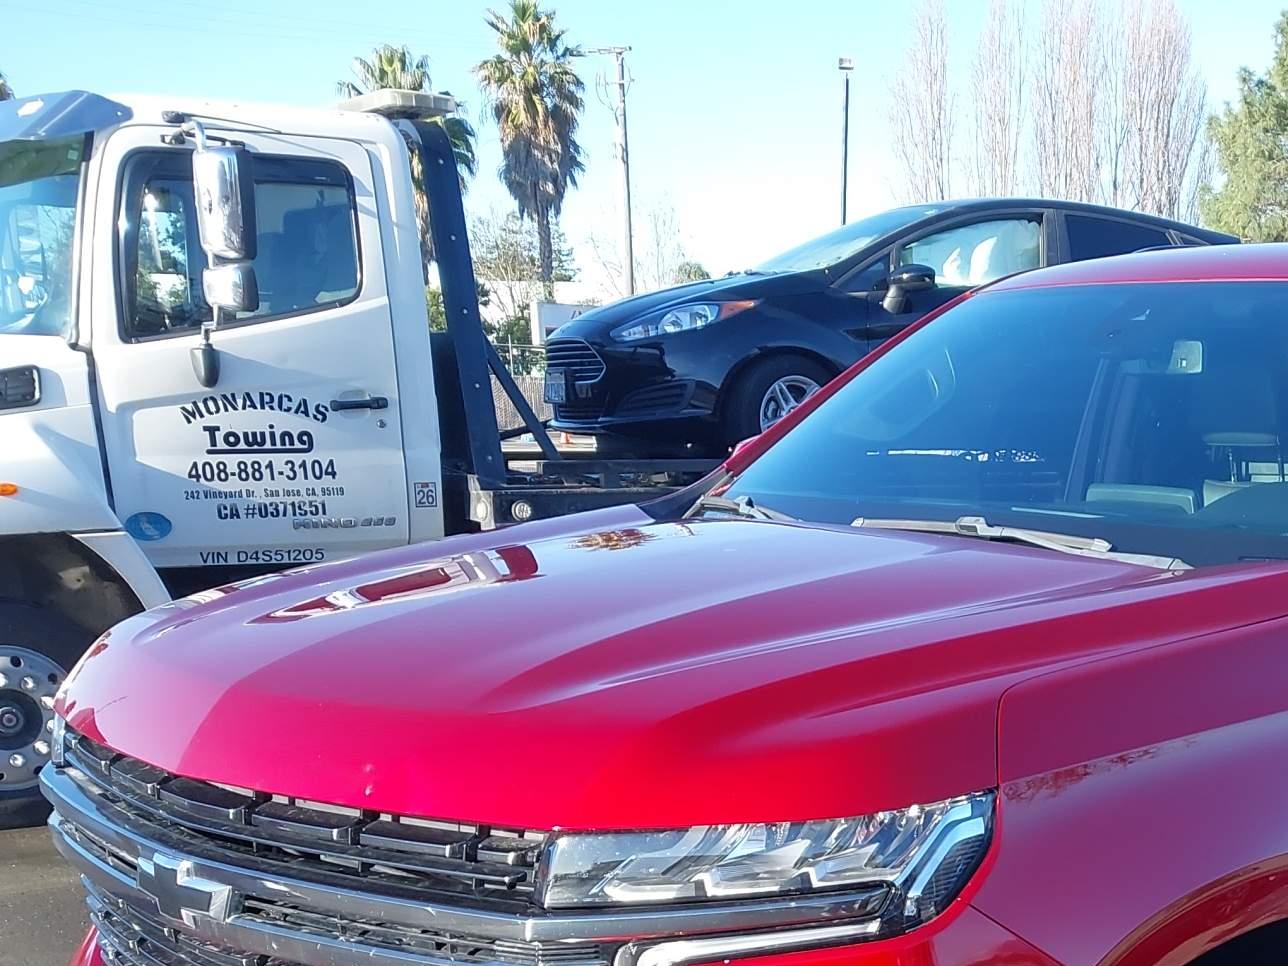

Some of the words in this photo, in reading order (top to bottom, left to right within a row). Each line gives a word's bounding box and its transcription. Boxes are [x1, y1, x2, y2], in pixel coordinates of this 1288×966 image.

[180, 392, 330, 424] MONARCAS
[203, 424, 314, 454] Towing
[187, 458, 337, 482] 408-881-3104
[184, 490, 201, 500] 242
[203, 488, 243, 500] Vineyard
[263, 487, 280, 498] San
[282, 488, 304, 498] Jose,
[305, 487, 319, 497] CA,
[320, 486, 345, 497] 95119
[417, 489, 435, 505] 26
[216, 502, 240, 520] CA
[200, 551, 229, 564] VIN
[237, 548, 325, 563] D4S51205
